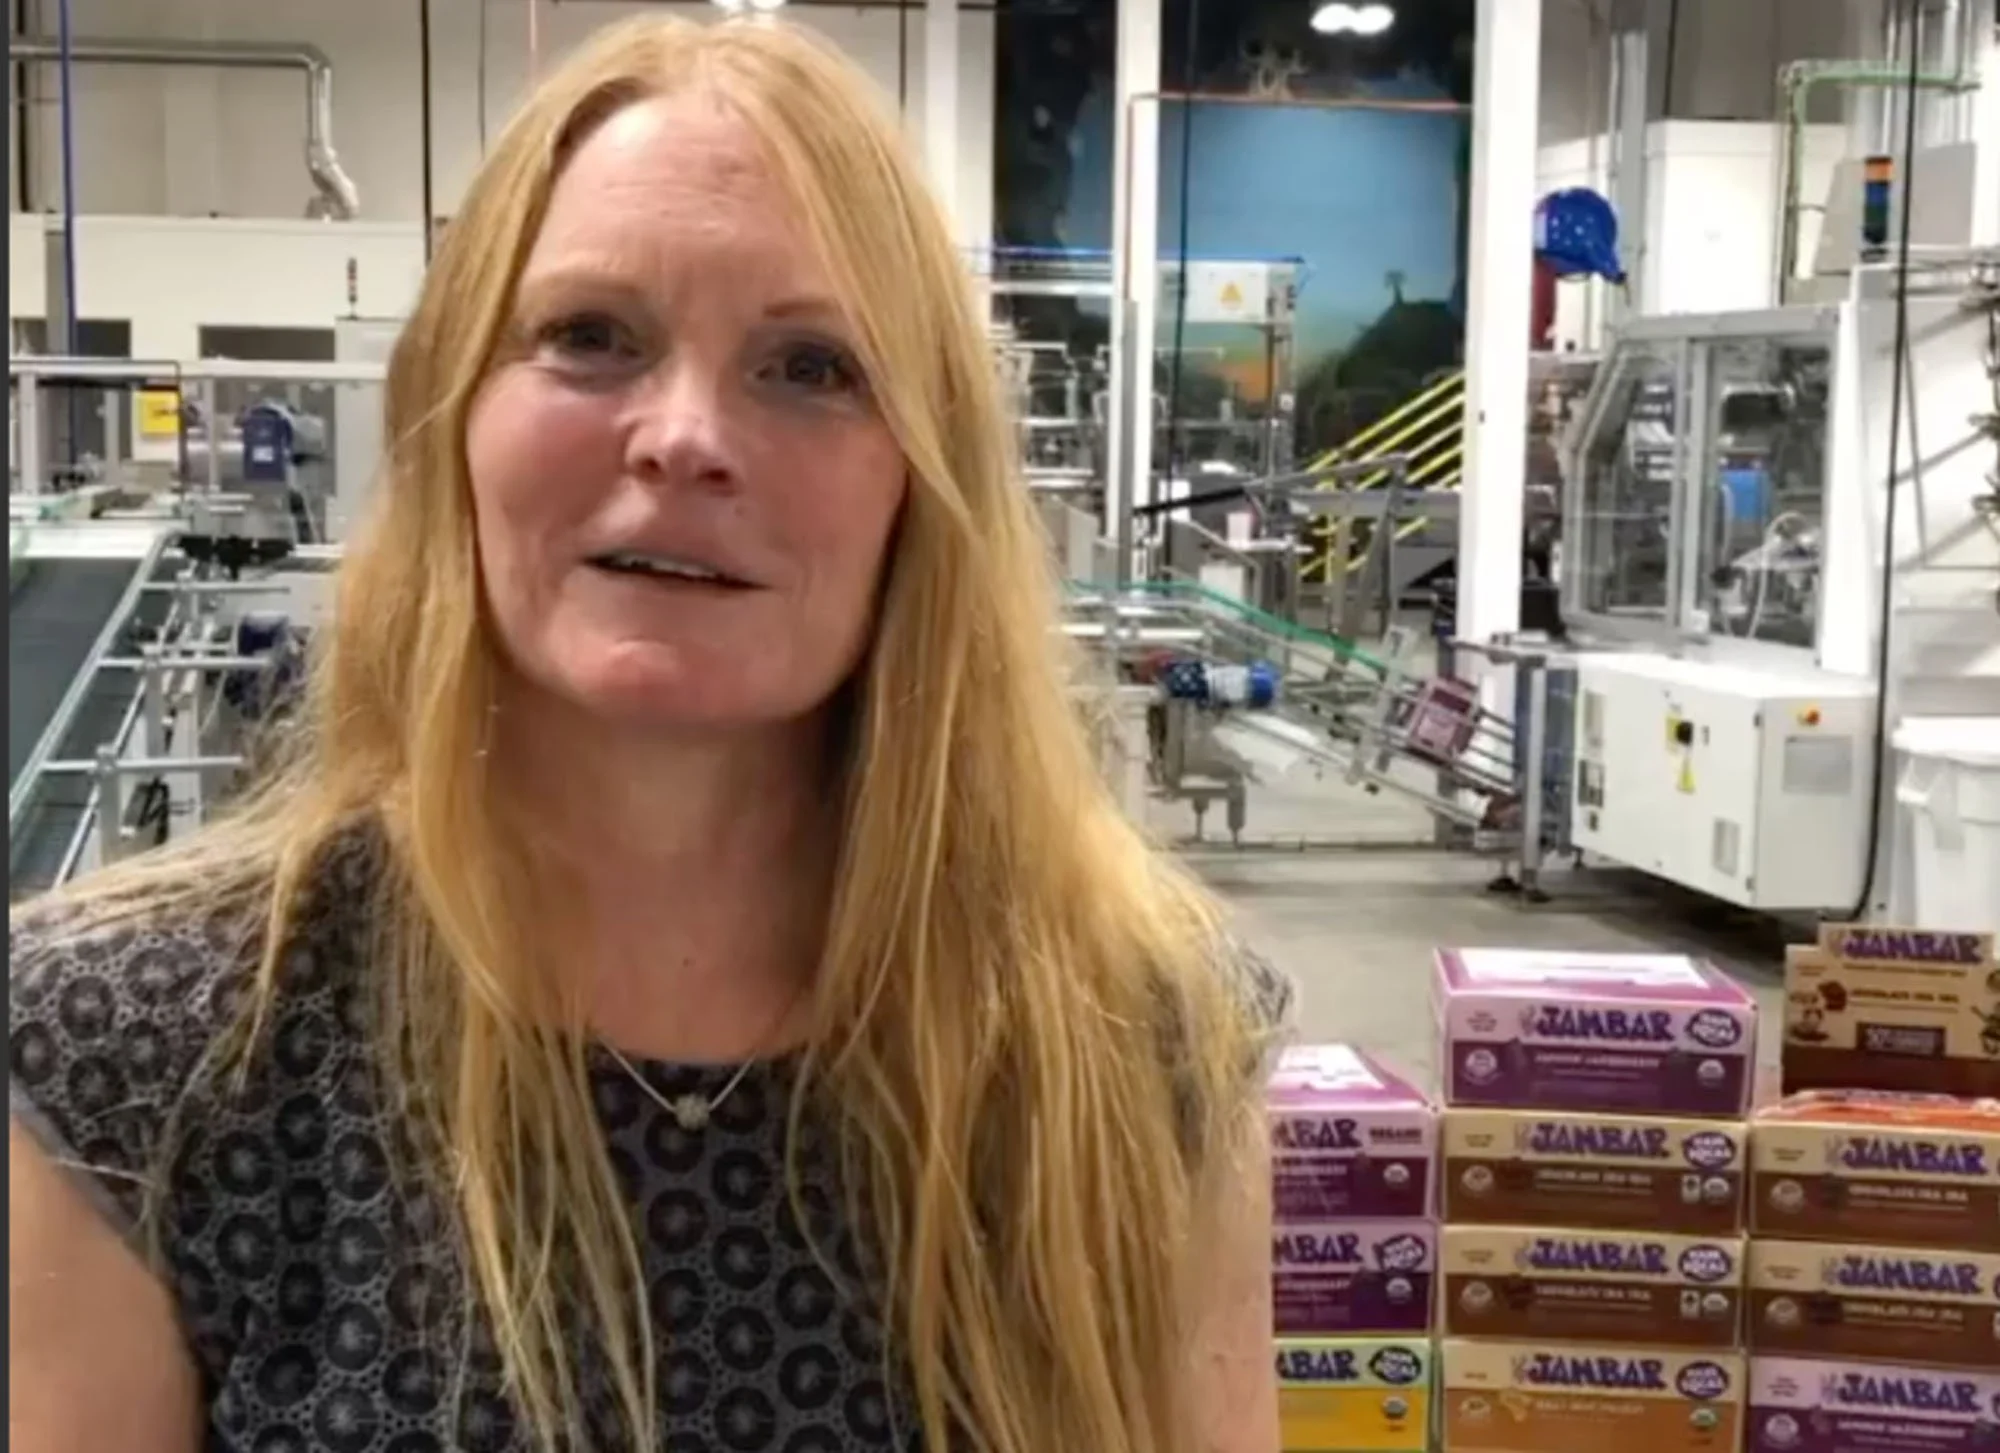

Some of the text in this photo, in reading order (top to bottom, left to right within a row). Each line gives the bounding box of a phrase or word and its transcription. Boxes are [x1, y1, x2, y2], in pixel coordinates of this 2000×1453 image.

[1842, 929, 1982, 964] JAMBAR
[1537, 1006, 1673, 1041] JAMBAR
[1272, 1119, 1363, 1148] MBAR
[1532, 1123, 1671, 1158] JAMBAR
[1842, 1137, 1988, 1174] JAMBAR
[1272, 1232, 1364, 1265] MBAR
[1531, 1239, 1669, 1274] JAMBAR
[1837, 1256, 1983, 1293] JAMBAR
[1275, 1350, 1360, 1379] BAR
[1528, 1354, 1668, 1390] JAMBAR
[1837, 1374, 1982, 1412] JAMBAR
